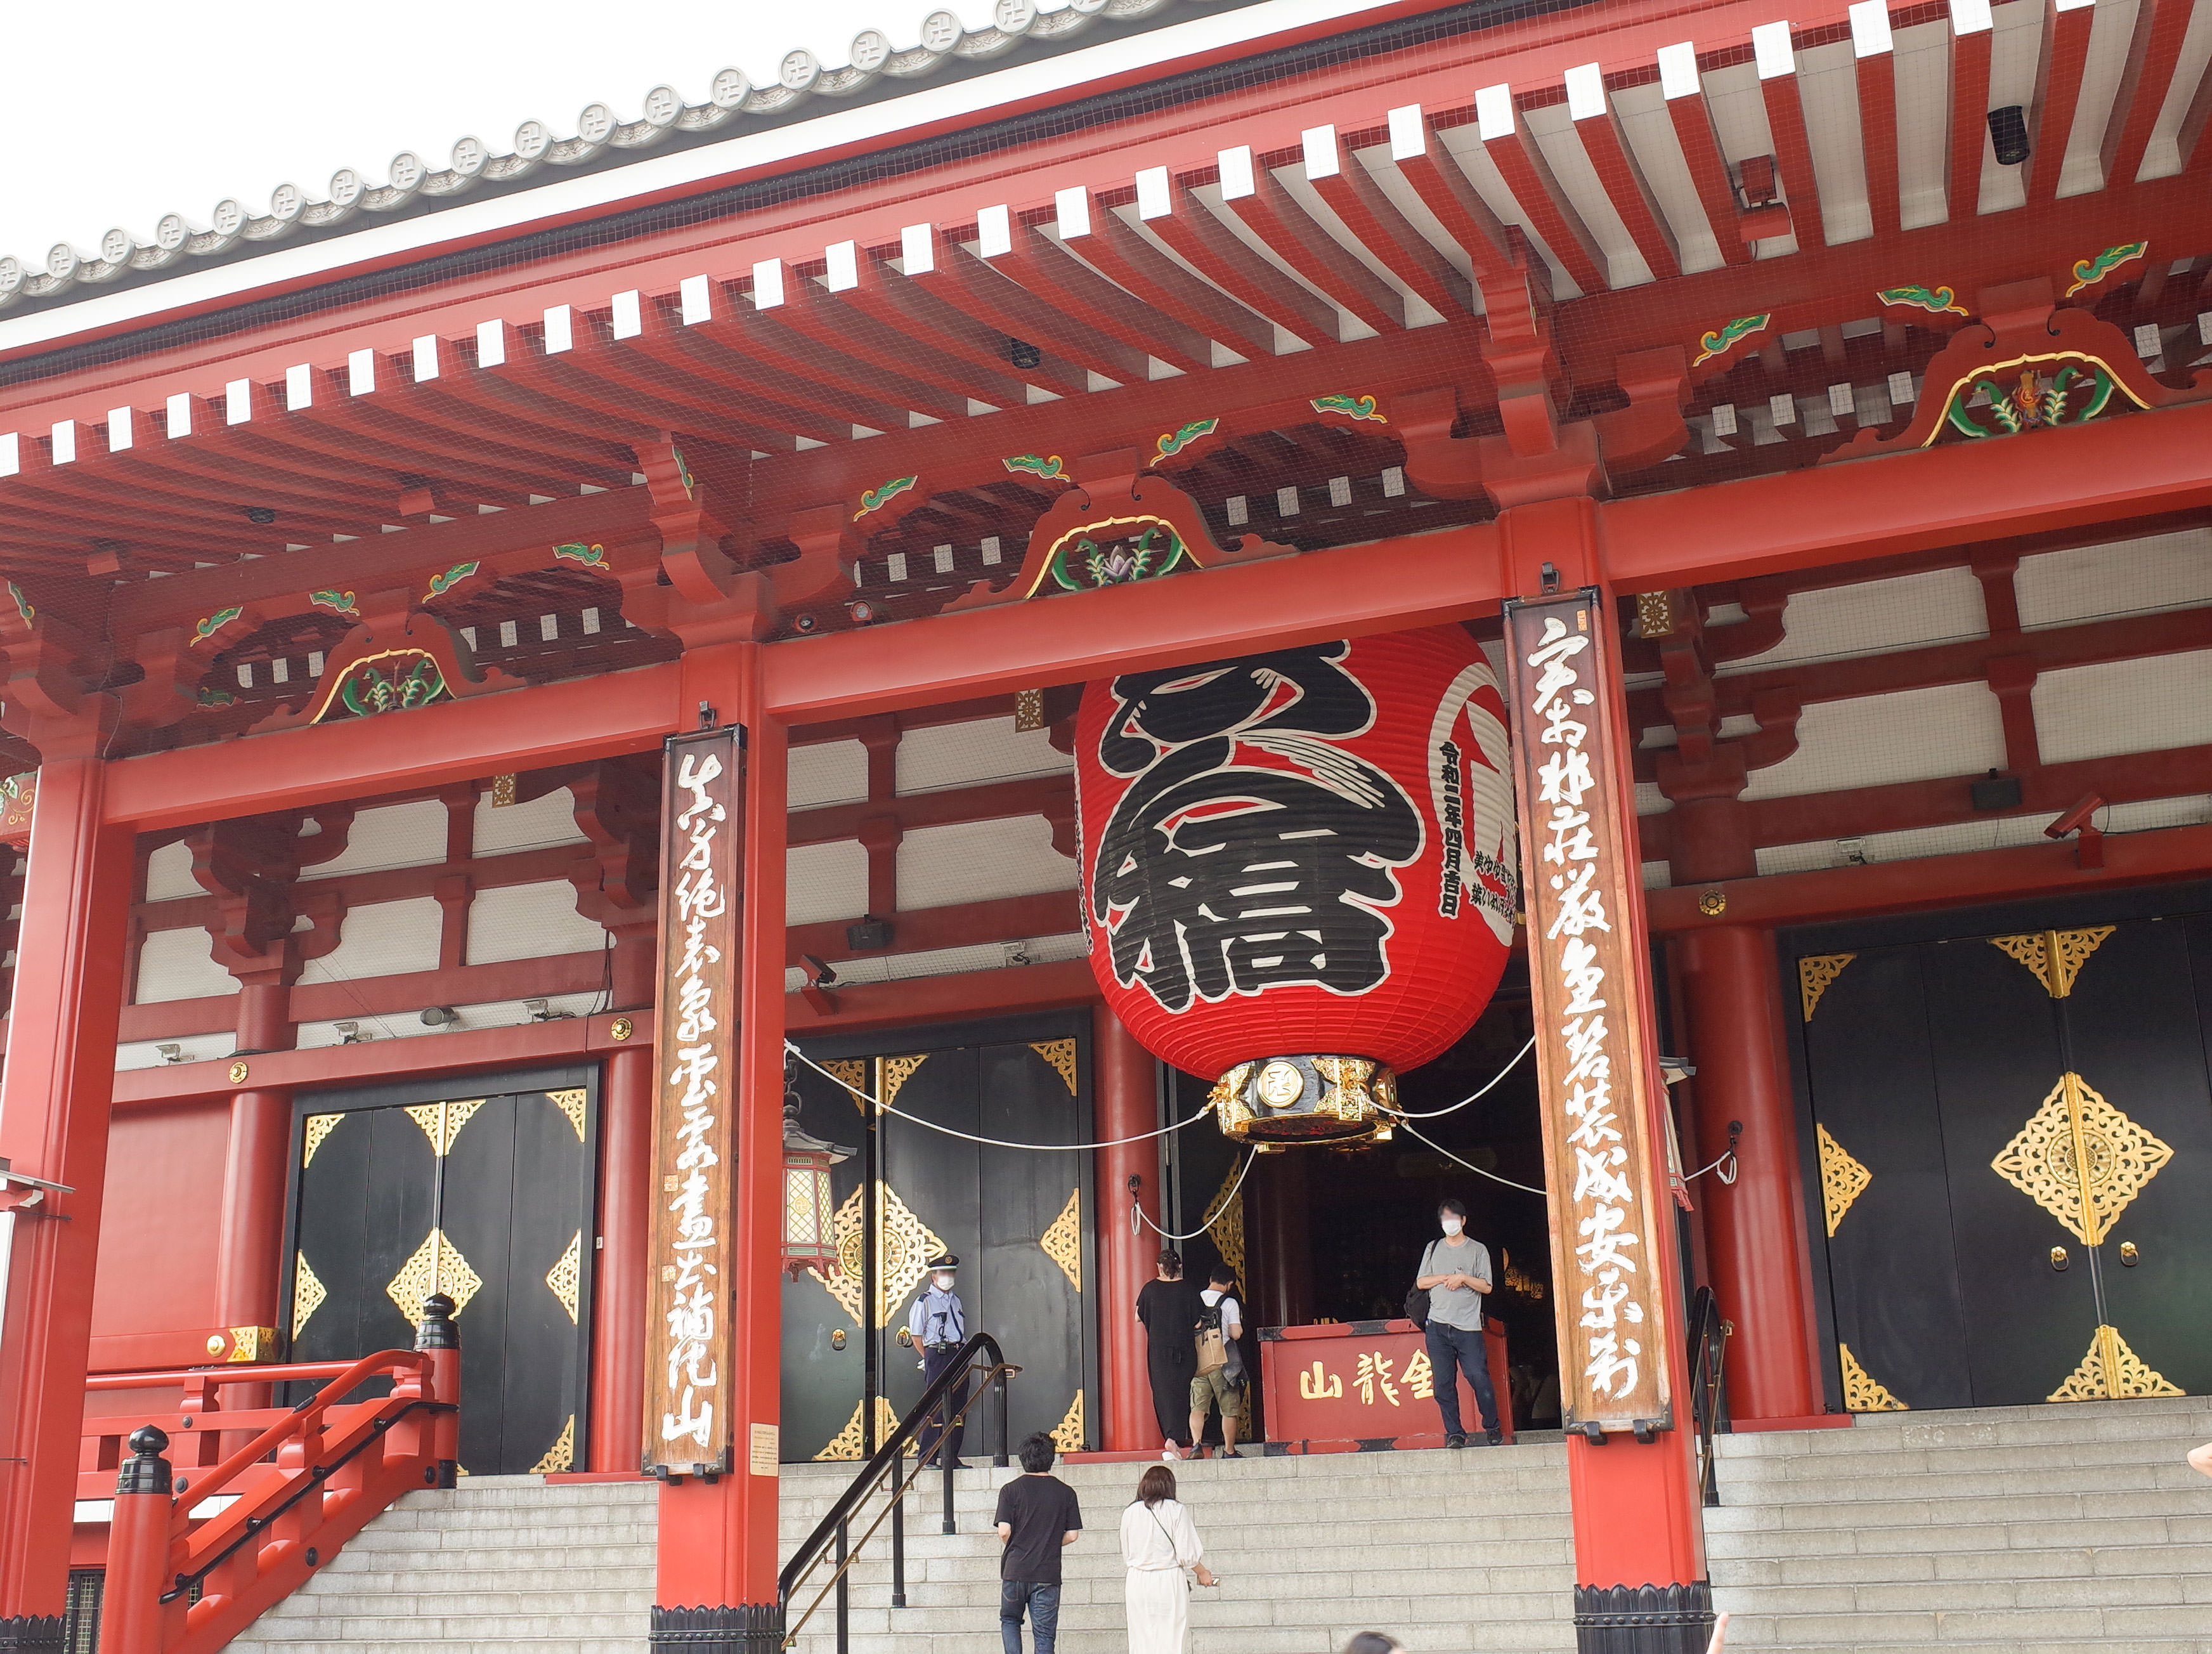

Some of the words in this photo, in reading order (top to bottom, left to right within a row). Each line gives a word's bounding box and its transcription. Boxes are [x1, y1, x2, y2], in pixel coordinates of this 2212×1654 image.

[1439, 740, 1462, 917] 令和二年四月吉日
